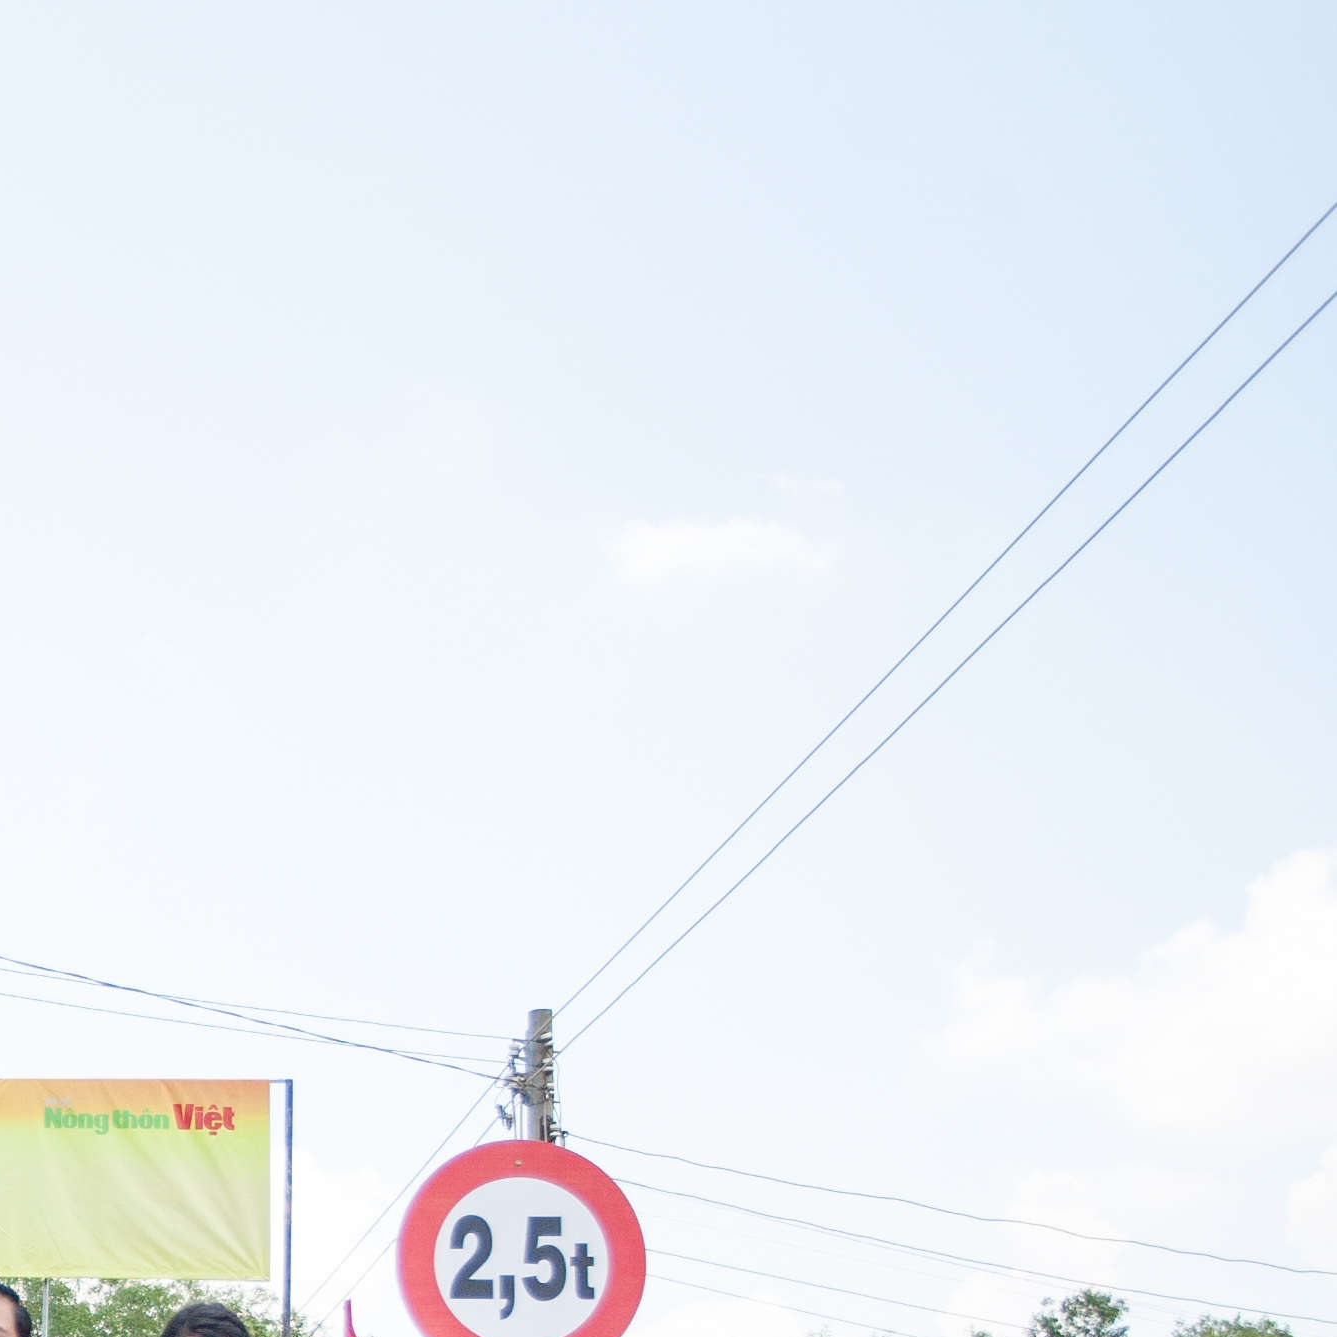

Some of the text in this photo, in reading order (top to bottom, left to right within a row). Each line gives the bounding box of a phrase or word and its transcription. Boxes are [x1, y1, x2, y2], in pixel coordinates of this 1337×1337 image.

[44, 1103, 236, 1136] Nông thôn Việt
[448, 1214, 596, 1320] 2,5t
